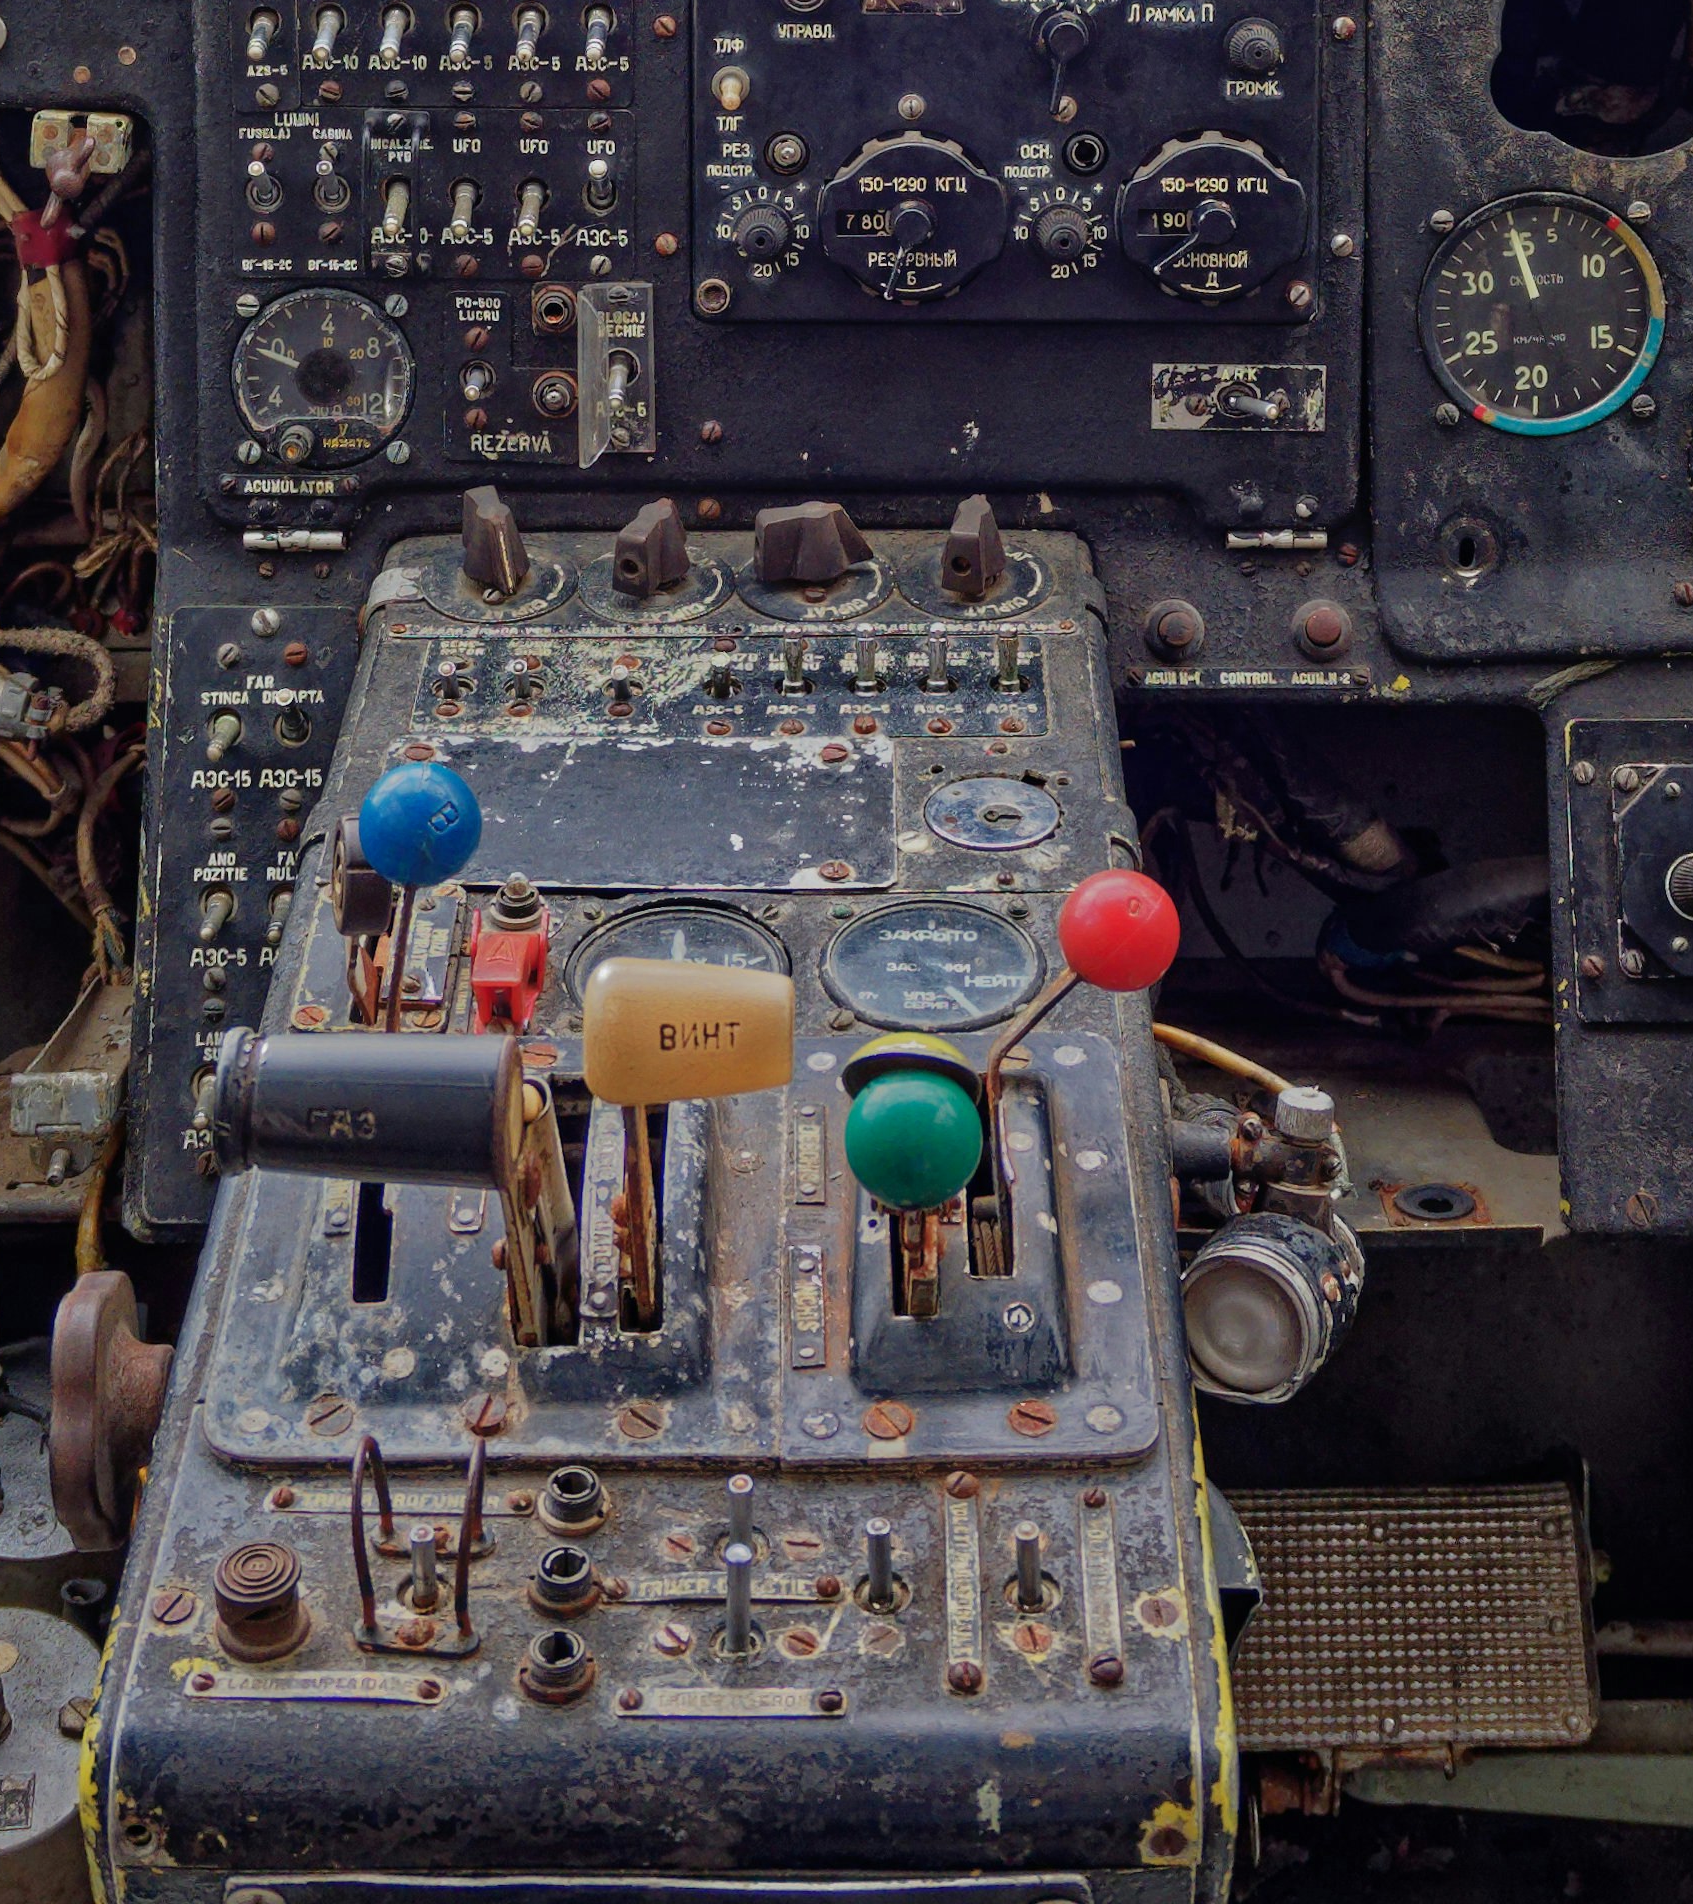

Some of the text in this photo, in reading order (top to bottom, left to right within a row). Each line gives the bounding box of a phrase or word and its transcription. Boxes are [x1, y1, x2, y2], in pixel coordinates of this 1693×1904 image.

[1145, 6, 1195, 22] РАМКА
[778, 24, 836, 39] УПРАВЛ.
[713, 38, 745, 53] ТЛФ
[1226, 81, 1282, 96] ГРОМК.
[717, 116, 743, 131] ТЛГ
[452, 138, 481, 154] UFO
[519, 139, 548, 155] UFO
[587, 139, 616, 155] UFO
[722, 144, 754, 158] РЕЗ.
[1020, 145, 1053, 160] ОСН.
[1004, 166, 1053, 178] ПОДСТР.
[758, 186, 767, 199] 0
[858, 177, 967, 194] 150-1290 КГЦ
[1160, 178, 1268, 194] 150-1290 КГЦ
[1055, 187, 1066, 200] 0
[732, 197, 741, 210] 5
[784, 196, 794, 210] 5
[1030, 198, 1040, 211] 5
[1082, 198, 1092, 211] 5
[716, 225, 731, 239] 10
[794, 225, 810, 239] 10
[1013, 226, 1029, 240] 10
[1092, 226, 1108, 240] 10
[1547, 228, 1558, 243] 5
[785, 252, 800, 267] 15
[867, 249, 957, 268] РЕЗРВНЫЙ
[1082, 254, 1097, 268] 15
[1582, 254, 1605, 278] 10
[753, 263, 773, 279] 20
[1051, 264, 1070, 279] 20
[1461, 271, 1494, 296] 30
[321, 312, 335, 334] 4
[323, 337, 333, 348] 10
[1465, 331, 1498, 356] 25
[1591, 325, 1614, 349] 15
[349, 337, 380, 359] 20 8
[1515, 365, 1548, 390] 20
[268, 385, 283, 407] 4
[244, 480, 335, 493] ACUMULATOR
[246, 675, 274, 689] FAR
[1220, 672, 1277, 685] CONTROL
[201, 691, 325, 705] STINGA DRAPTA
[193, 868, 248, 882] POZITIE
[879, 930, 978, 942] ЗАКРЫТО
[659, 1022, 742, 1051] ВИНТ
[310, 1108, 378, 1141] ГАЗ
